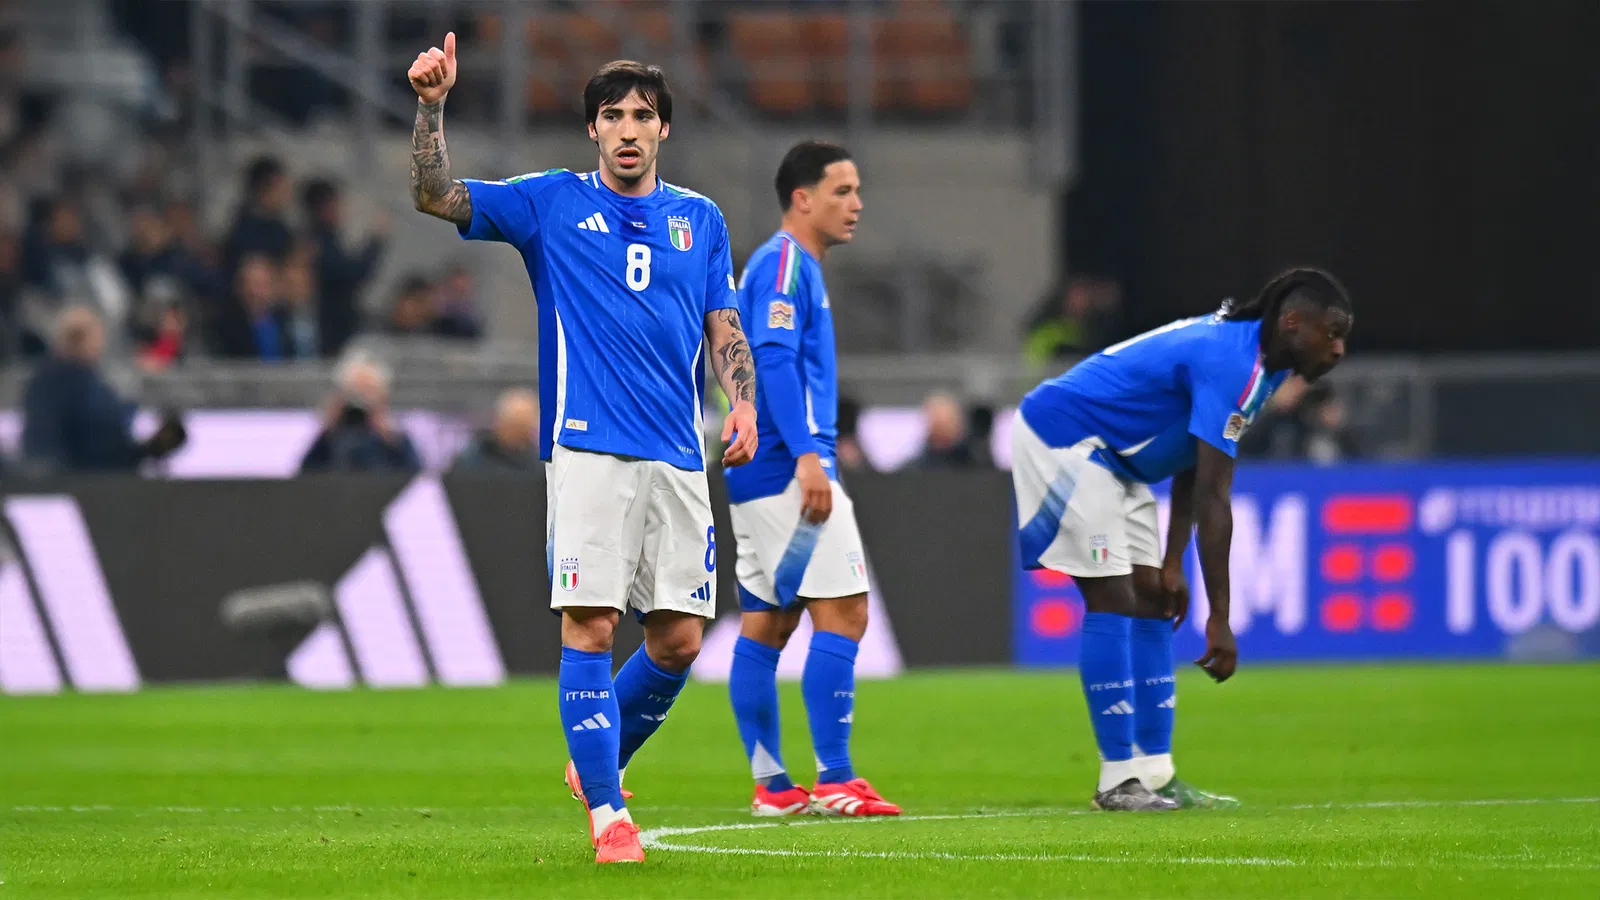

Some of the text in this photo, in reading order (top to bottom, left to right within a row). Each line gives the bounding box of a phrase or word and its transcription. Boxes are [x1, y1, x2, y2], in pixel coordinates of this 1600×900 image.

[670, 221, 689, 230] ITALIA
[626, 243, 651, 291] 8
[704, 525, 717, 573] 8
[566, 690, 609, 701] ITALIA
